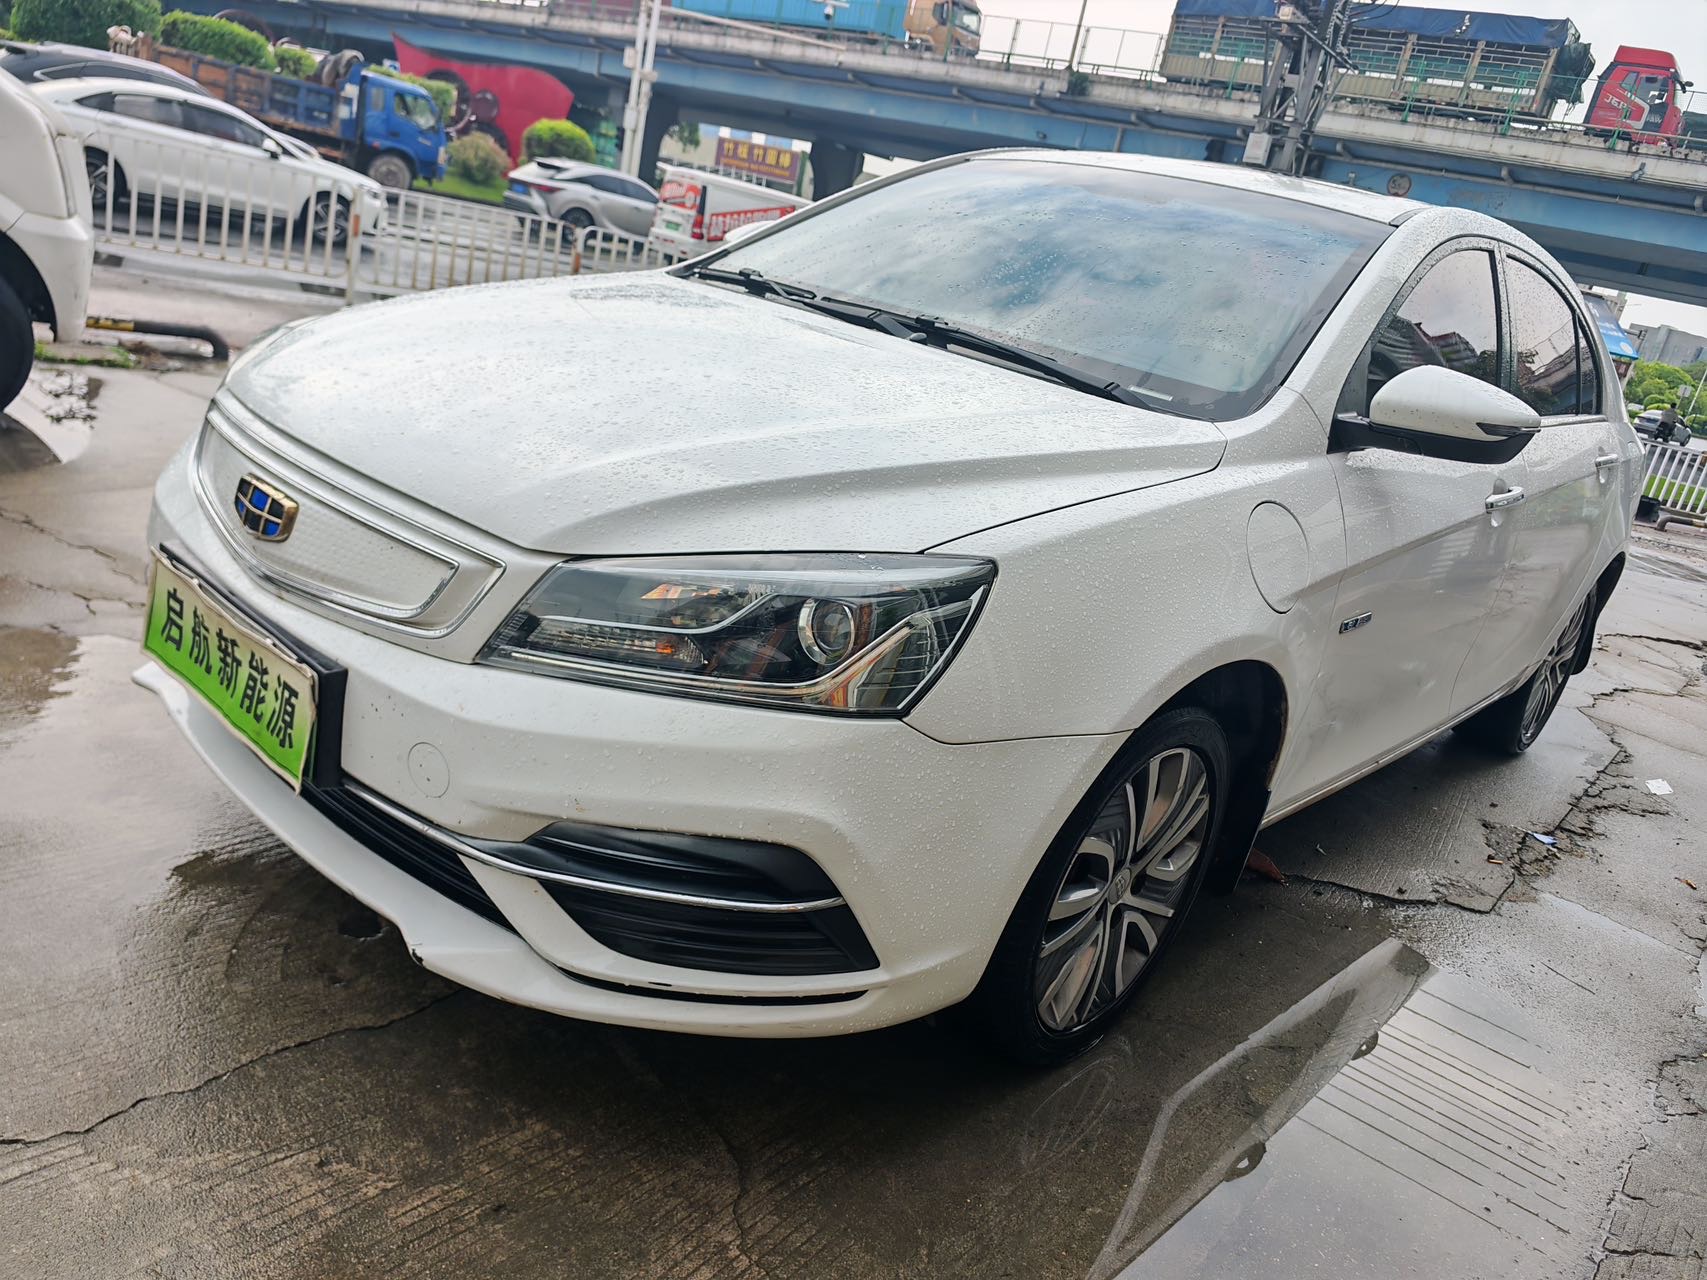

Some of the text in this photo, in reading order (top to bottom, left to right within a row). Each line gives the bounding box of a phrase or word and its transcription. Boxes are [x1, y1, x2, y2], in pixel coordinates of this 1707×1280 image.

[160, 587, 300, 750] 启航新能源
